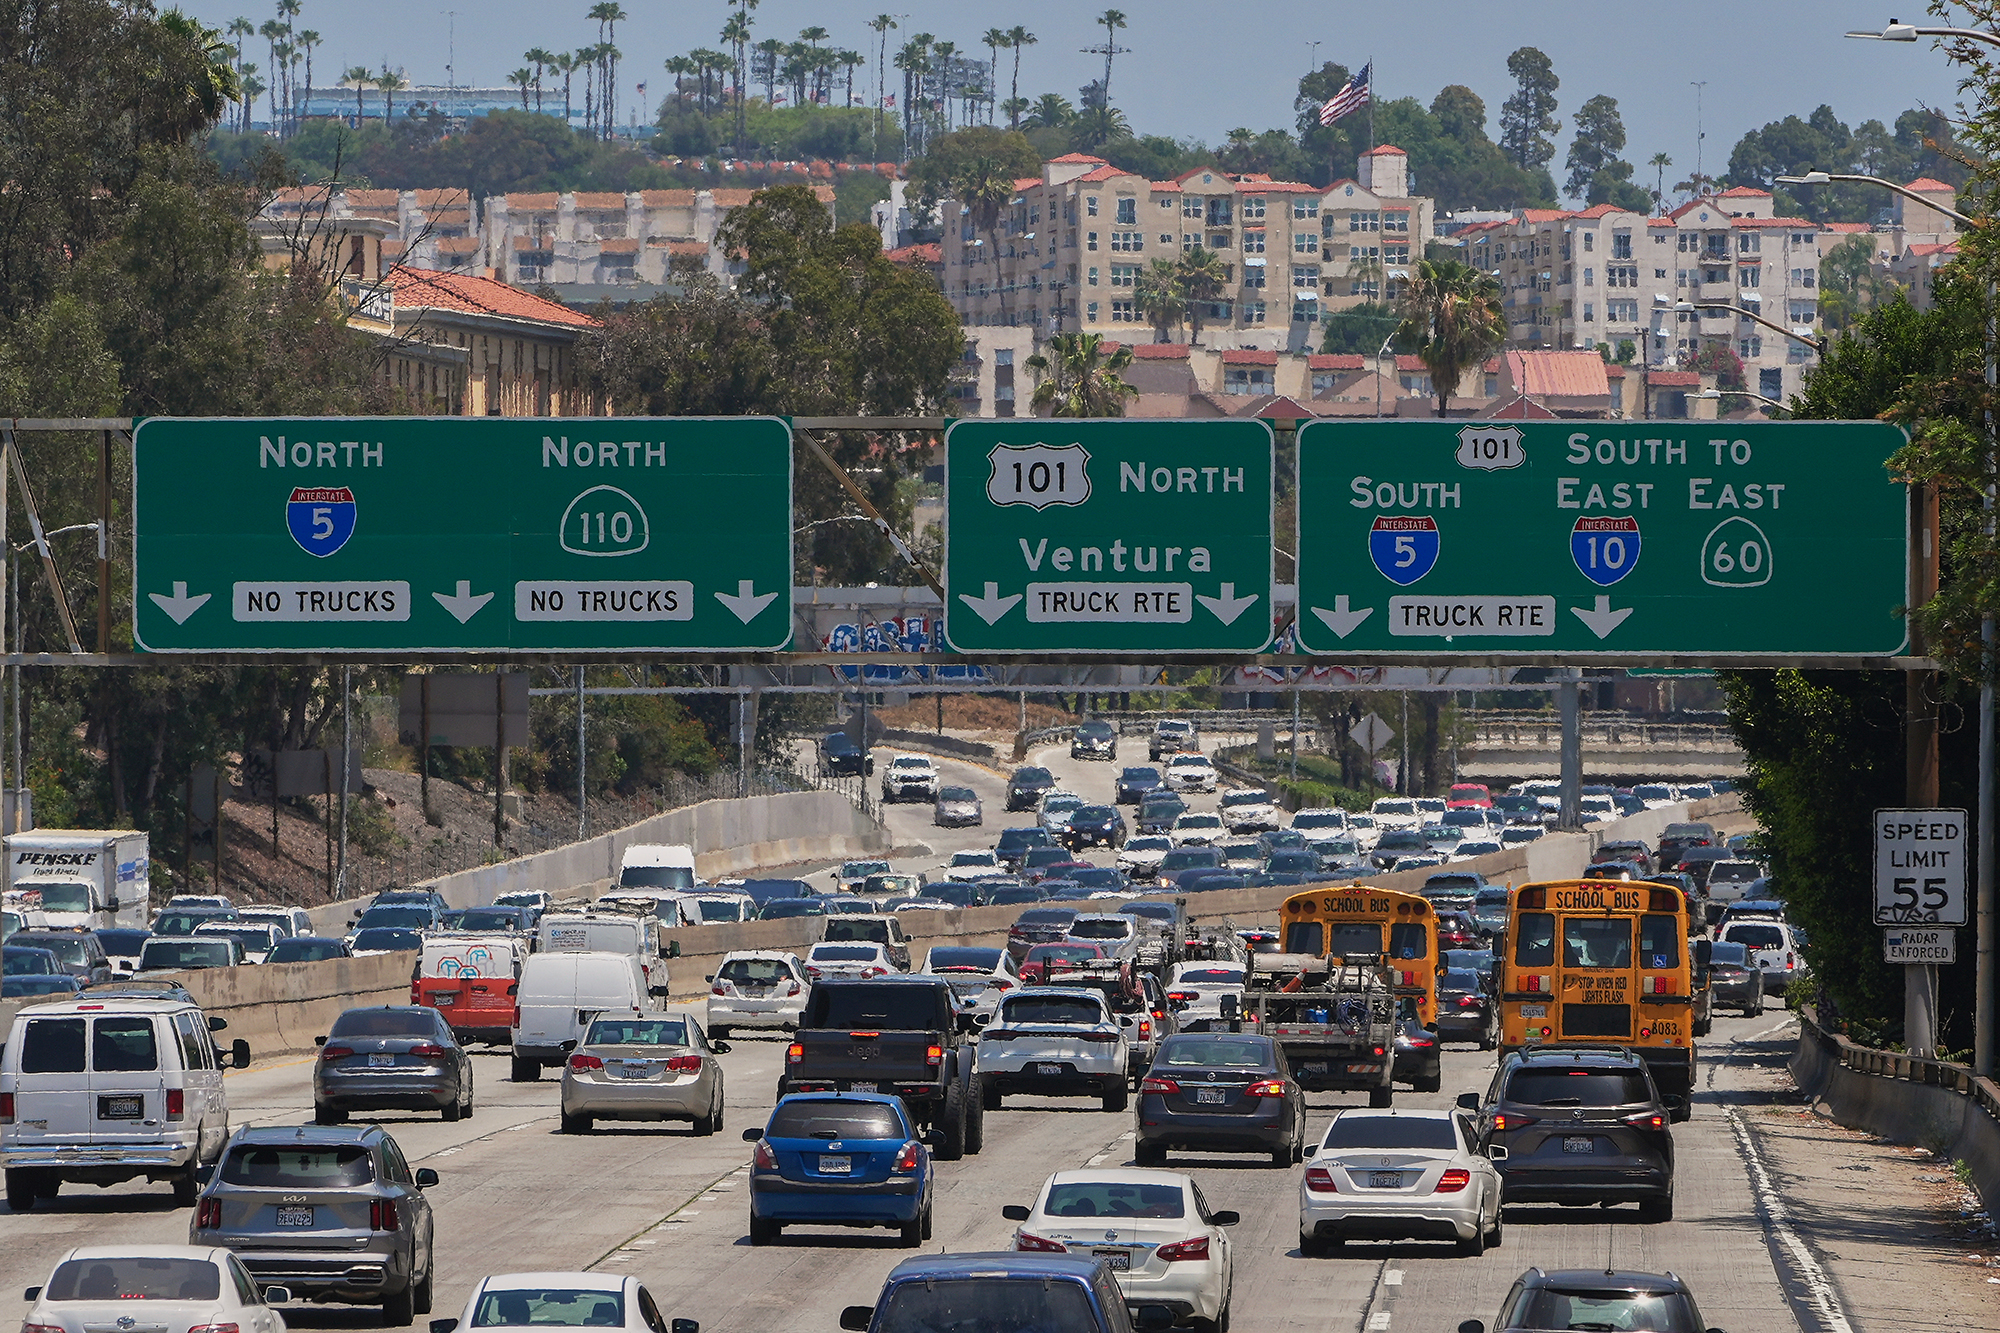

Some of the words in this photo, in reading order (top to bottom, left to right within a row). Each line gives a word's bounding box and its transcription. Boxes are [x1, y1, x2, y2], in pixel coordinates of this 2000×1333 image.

[259, 435, 383, 468] NORTH
[542, 435, 666, 468] NORTH
[1472, 438, 1509, 460] 101
[1566, 433, 1687, 465] SOUTH
[1708, 439, 1752, 465] TO
[1013, 462, 1065, 493] 101
[1120, 461, 1244, 493] NORTH
[297, 491, 346, 501] INTERSTATE
[1350, 476, 1461, 509] SOUTH
[1557, 477, 1654, 509] EAST
[1688, 477, 1785, 509] EAST
[311, 507, 334, 540] 5
[580, 511, 633, 544] 110
[1380, 519, 1428, 530] INTERSTATE
[1582, 520, 1629, 530] INTERSTATE
[1019, 538, 1211, 572] Ventura
[1394, 536, 1417, 568] 5
[1588, 536, 1626, 569] 10
[1713, 540, 1762, 573] 60
[248, 590, 281, 612] NO
[295, 590, 396, 612] TRUCKS
[530, 590, 563, 612] NO
[577, 590, 678, 612] TRUCKS
[1038, 591, 1120, 613] TRUCK
[1133, 591, 1181, 613] RTE
[1400, 604, 1484, 627] TRUCK
[1498, 604, 1544, 627] RTE
[1883, 823, 1959, 840] SPEED
[16, 852, 97, 866] PENSKE
[1891, 850, 1950, 868] LIMIT
[1324, 897, 1365, 913] SCHOOL
[1370, 898, 1390, 913] BUS
[1556, 891, 1606, 909] SCHOOL
[1614, 891, 1640, 909] BUS
[1892, 878, 1949, 910] 55
[1901, 932, 1939, 945] RADAR
[1891, 946, 1949, 959] ENFORCED
[1579, 976, 1594, 989] STOP
[1596, 976, 1614, 989] WHEN
[1615, 976, 1627, 990] RED
[1582, 990, 1603, 1003] LIGHTS
[1604, 990, 1624, 1003] FLASH
[1652, 1022, 1677, 1035] 8083
[847, 1046, 880, 1057] Jeep
